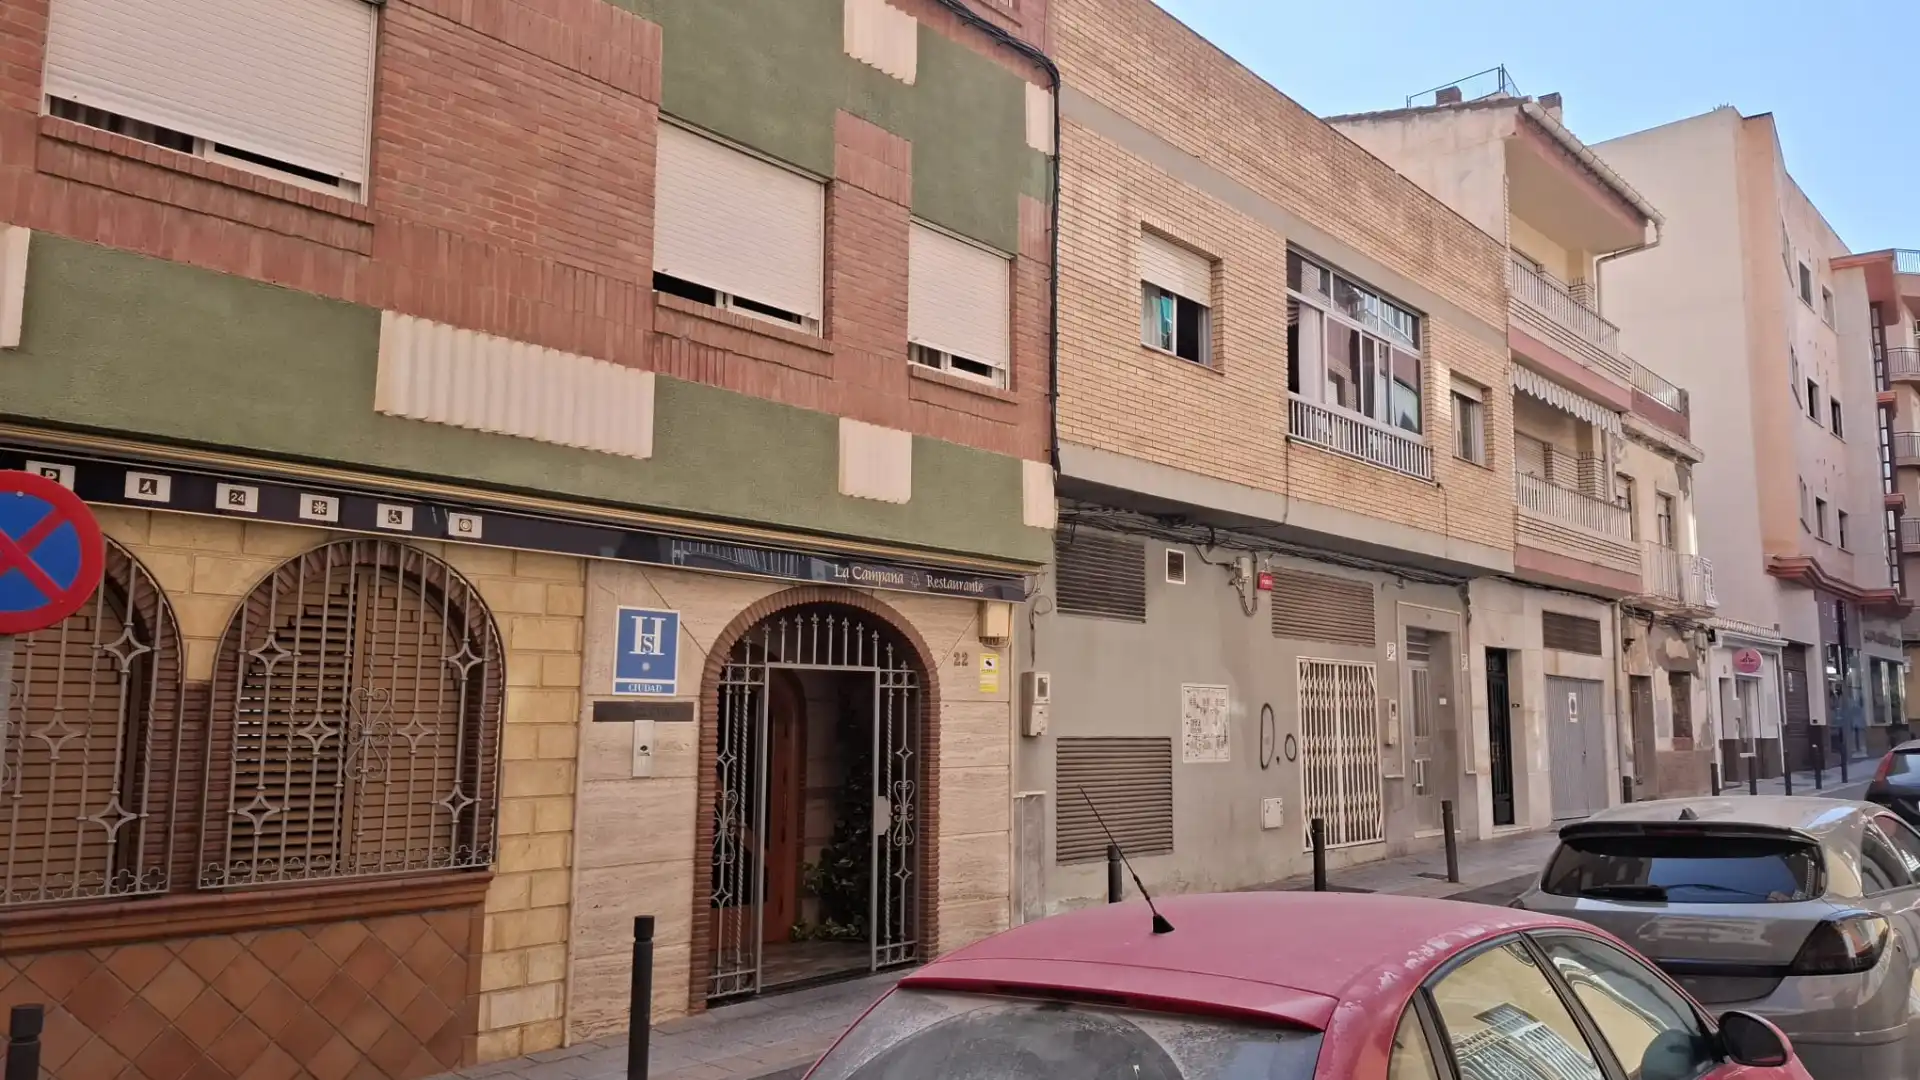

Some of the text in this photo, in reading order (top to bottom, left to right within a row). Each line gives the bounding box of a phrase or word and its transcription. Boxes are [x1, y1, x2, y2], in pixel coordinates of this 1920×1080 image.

[230, 492, 245, 503] 24
[834, 563, 985, 593] La Campana Restaurante
[953, 652, 969, 667] 22
[628, 683, 663, 693] CIUDAD
